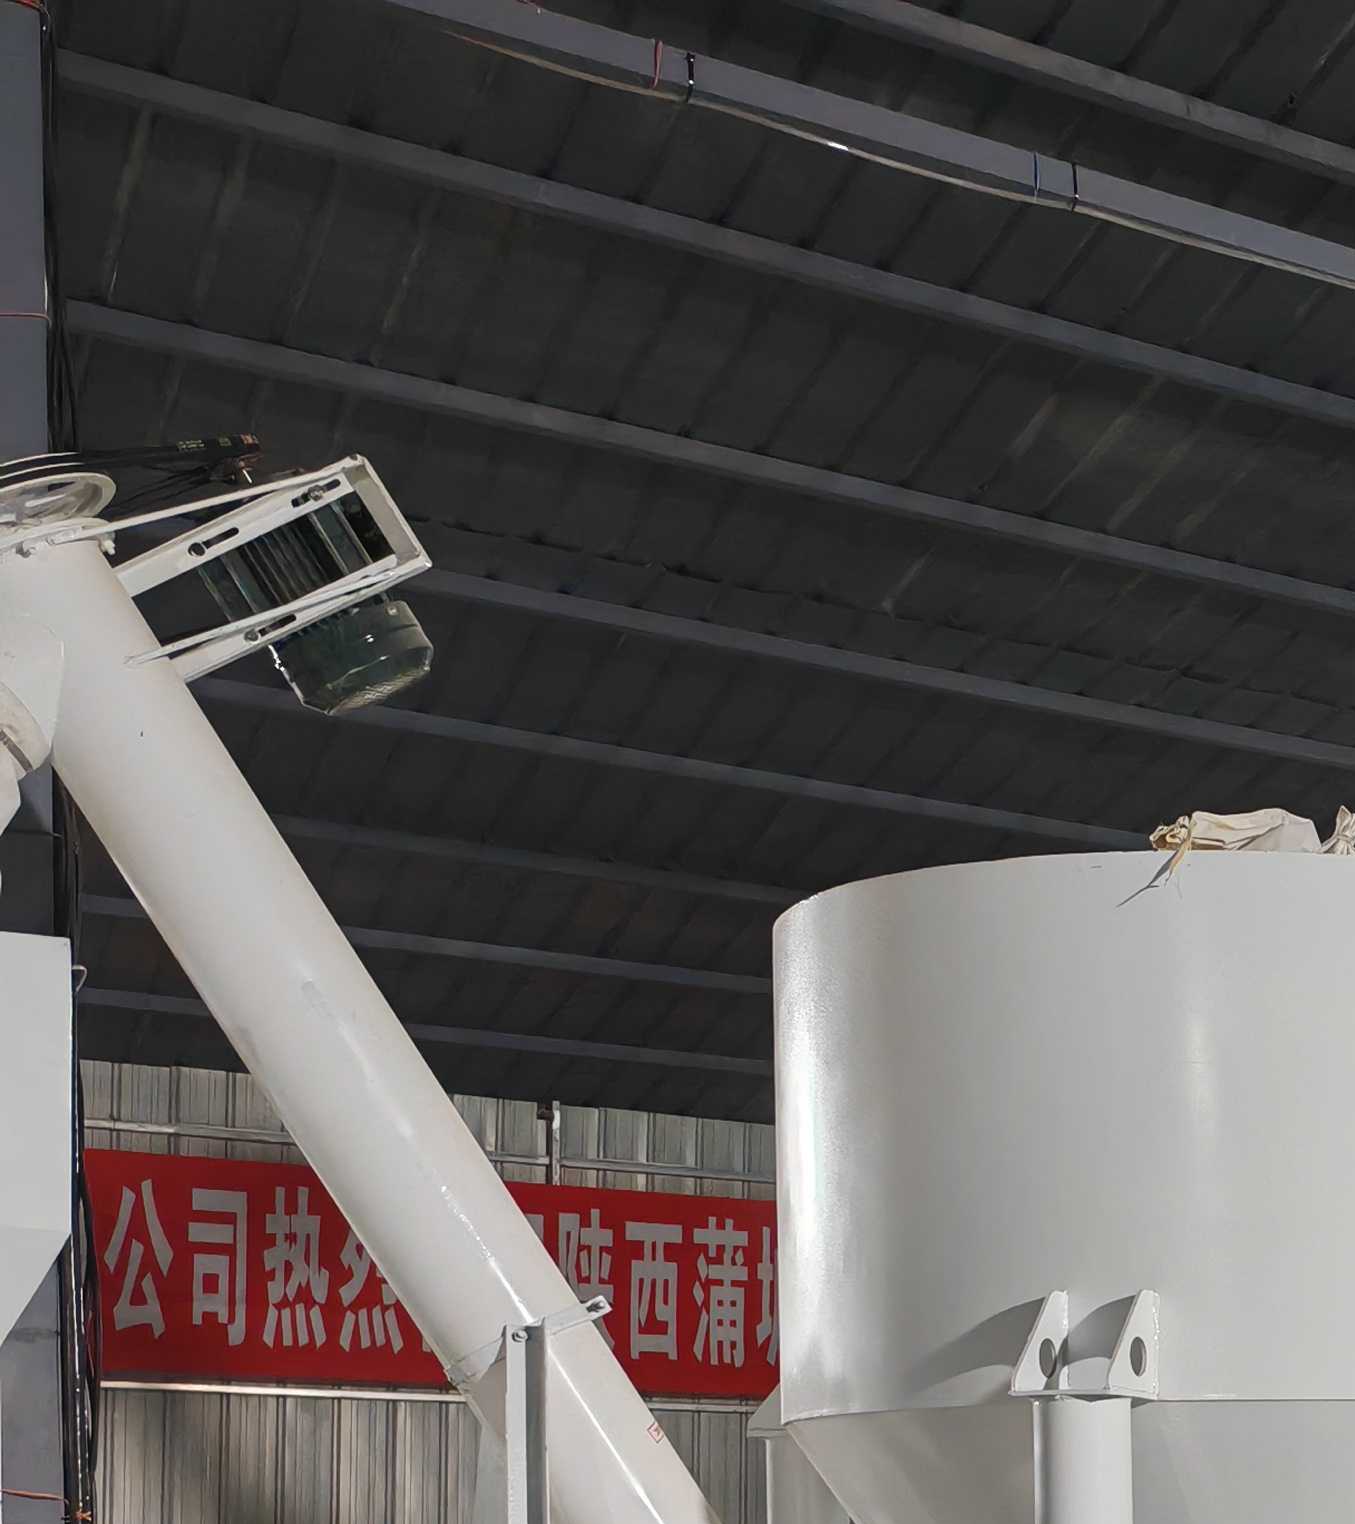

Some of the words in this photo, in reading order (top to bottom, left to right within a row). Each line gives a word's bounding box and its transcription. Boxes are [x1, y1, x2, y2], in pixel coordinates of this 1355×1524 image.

[104, 1178, 434, 1355] 公司热烈
[525, 1208, 777, 1368] 陕西蒲
